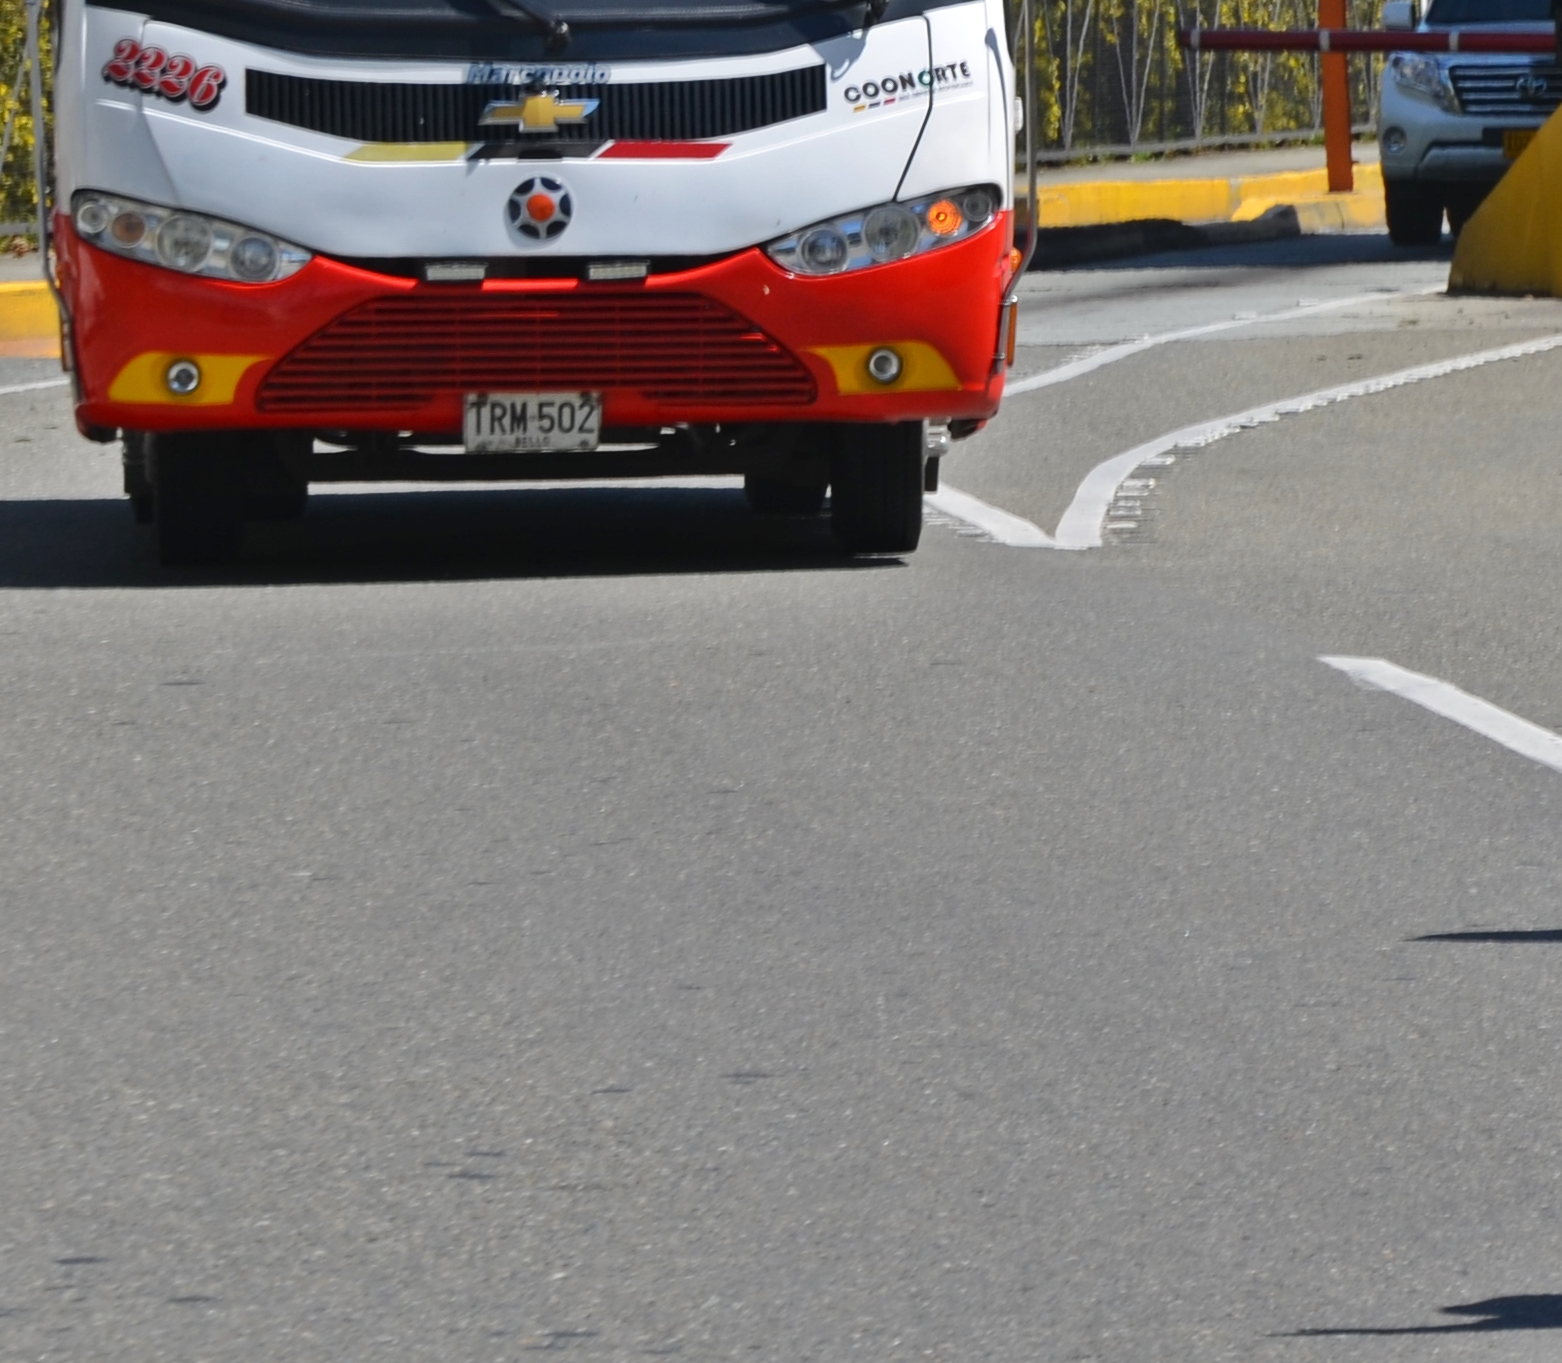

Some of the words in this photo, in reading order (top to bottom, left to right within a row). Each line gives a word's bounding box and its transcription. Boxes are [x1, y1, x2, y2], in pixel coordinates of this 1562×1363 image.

[102, 37, 226, 110] 2226
[843, 60, 971, 103] COONORTE
[469, 400, 528, 435] TRM
[537, 398, 597, 434] 502
